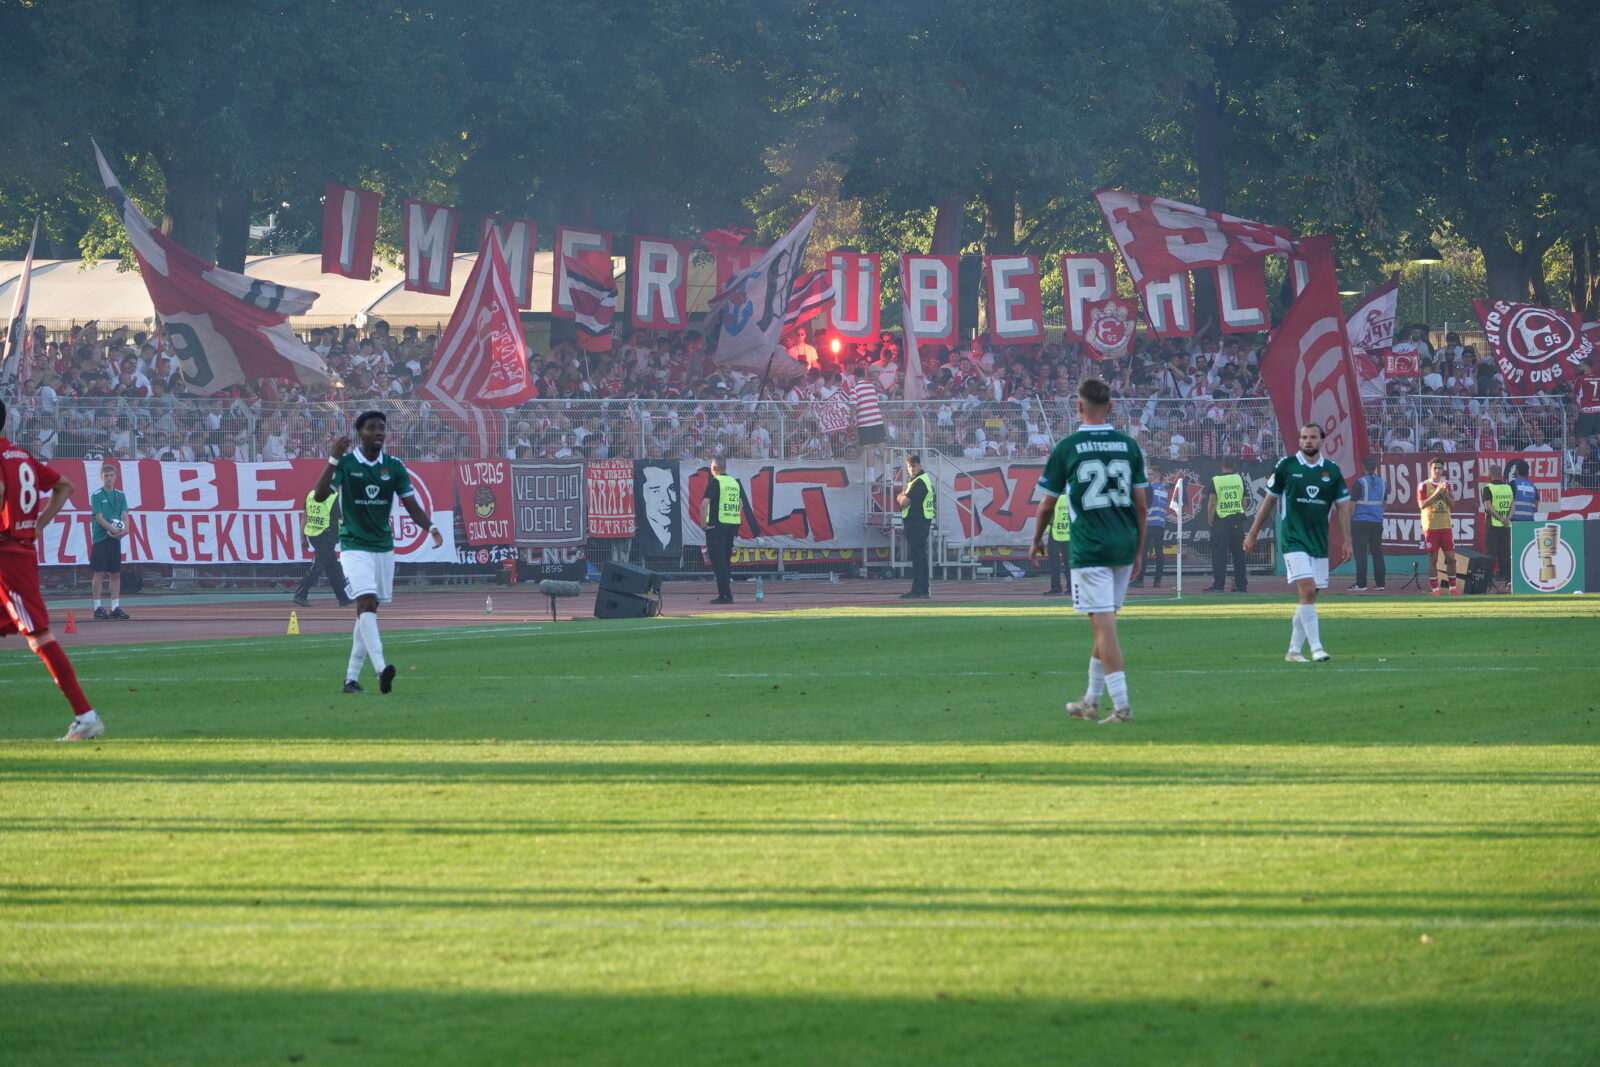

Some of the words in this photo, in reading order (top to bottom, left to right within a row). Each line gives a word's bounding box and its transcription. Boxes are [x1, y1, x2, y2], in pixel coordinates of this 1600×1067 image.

[339, 188, 683, 326] IMMER
[1544, 333, 1561, 346] 95
[1498, 357, 1524, 383] MIT
[1530, 364, 1562, 383] UNS
[1590, 381, 1598, 397] 7
[1075, 440, 1128, 454] KRÄTSCHMER
[19, 461, 37, 514] 8
[515, 474, 579, 501] VECCHIO
[588, 479, 634, 514] KRAFT
[1077, 459, 1131, 511] 23
[521, 506, 574, 532] IDEALE
